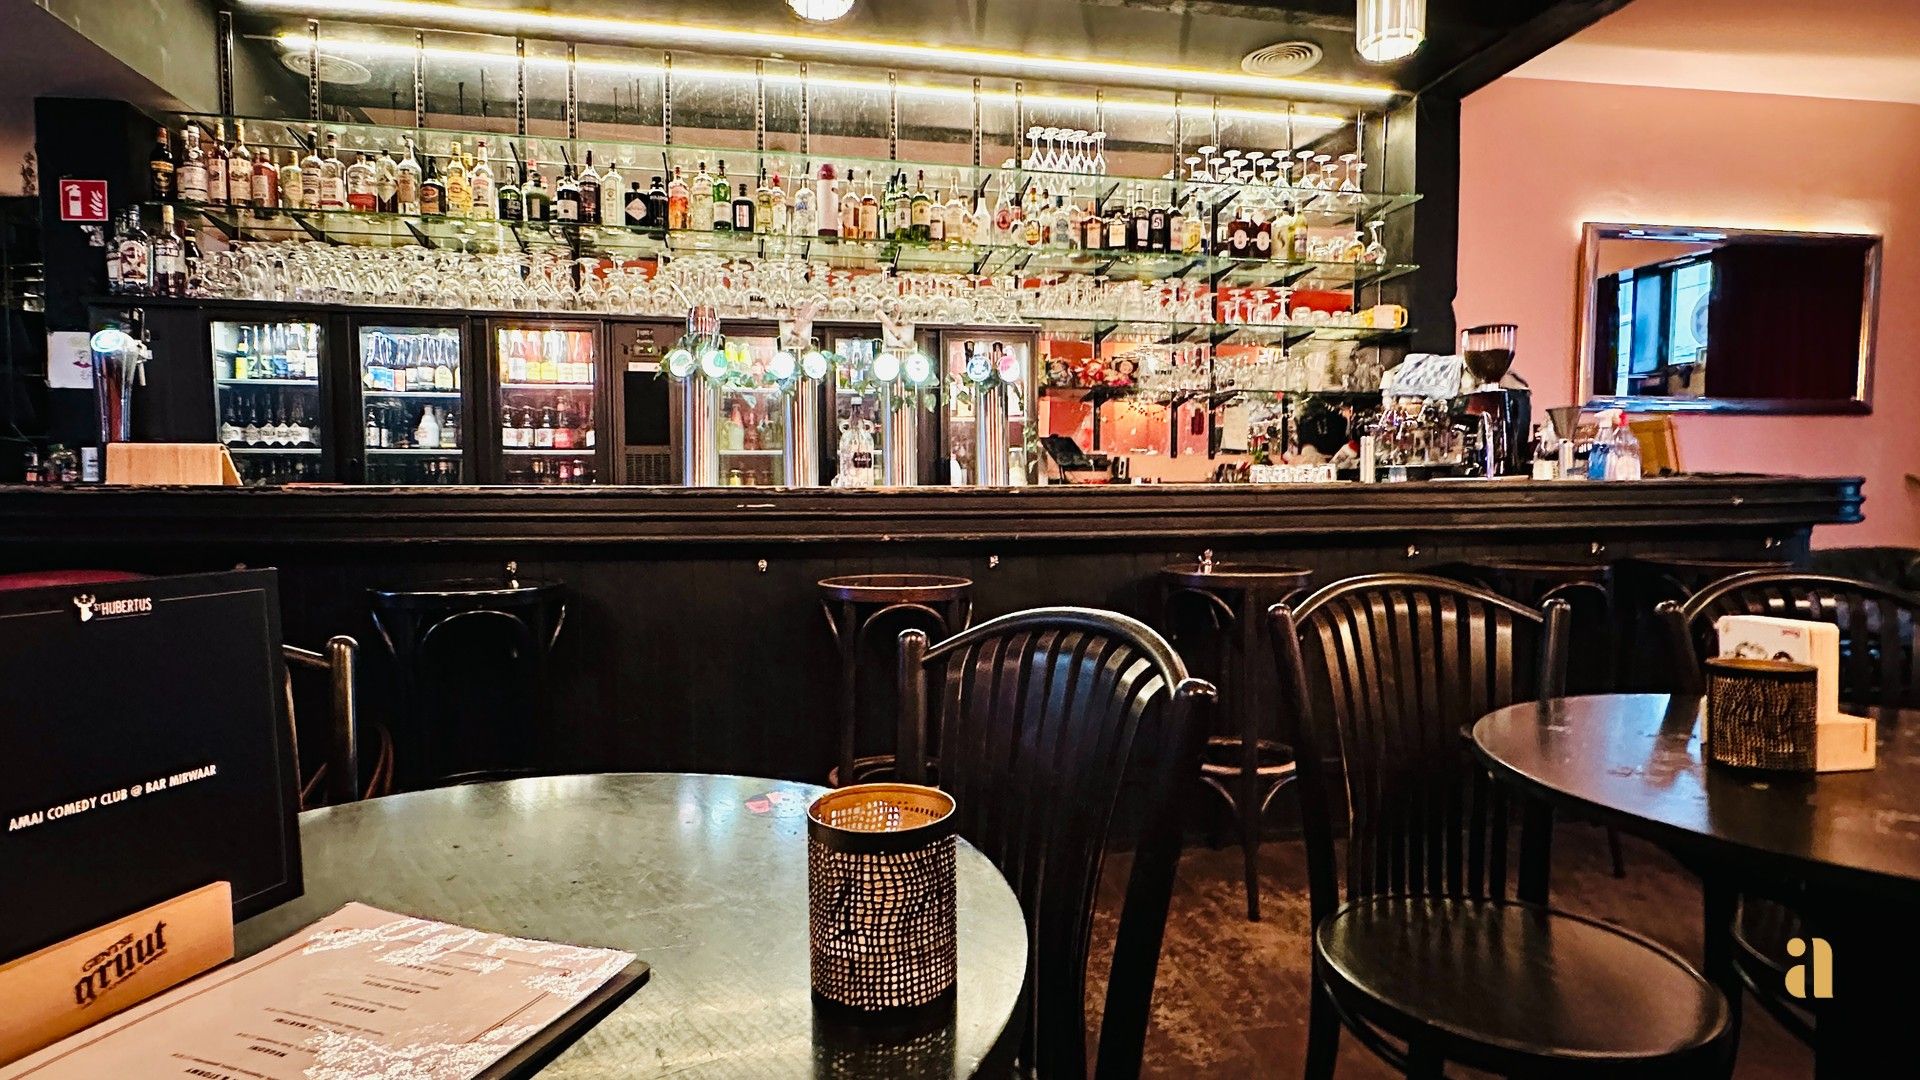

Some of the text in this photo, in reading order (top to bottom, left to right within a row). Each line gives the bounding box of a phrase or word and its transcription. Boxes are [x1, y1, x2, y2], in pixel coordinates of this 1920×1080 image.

[101, 597, 153, 616] HUBERTUS
[46, 796, 98, 821] COMEDY
[99, 788, 128, 806] CLUB
[130, 784, 143, 797] @
[145, 777, 167, 794] BAR
[168, 764, 218, 787] MIRWAAR
[247, 1045, 288, 1058] NEGRONI
